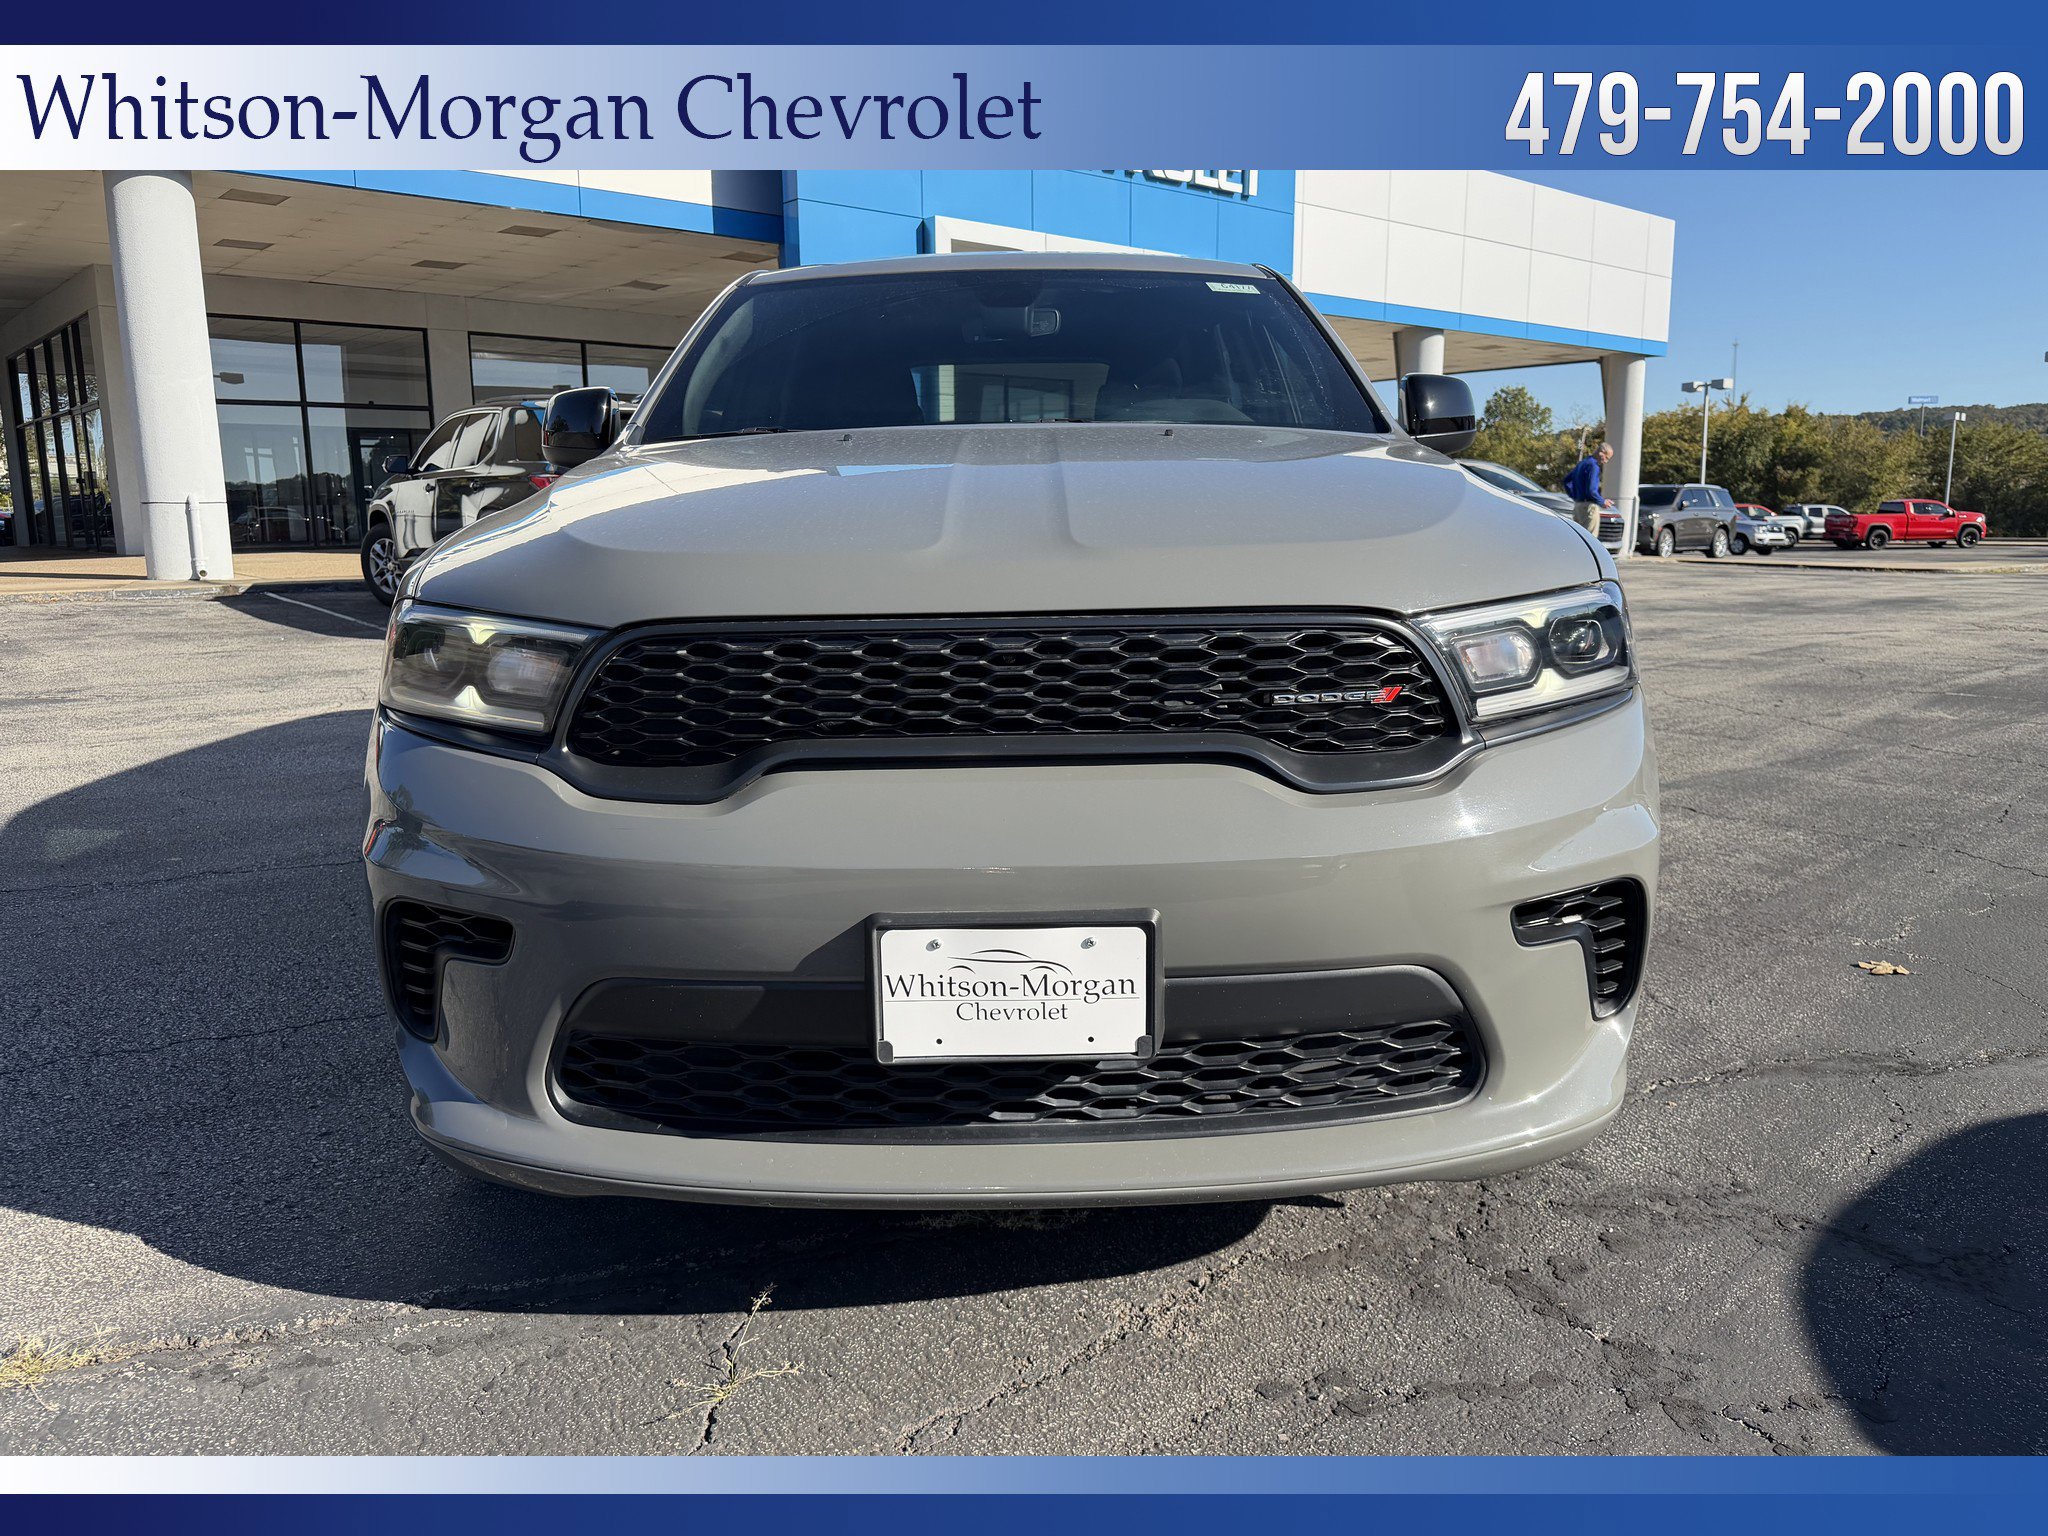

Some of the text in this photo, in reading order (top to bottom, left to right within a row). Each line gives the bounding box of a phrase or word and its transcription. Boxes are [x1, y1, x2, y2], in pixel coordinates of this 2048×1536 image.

[1272, 690, 1387, 705] DODGE
[884, 973, 1137, 1004] Whitson-Morgan
[956, 1001, 1069, 1022] Chevrolet
